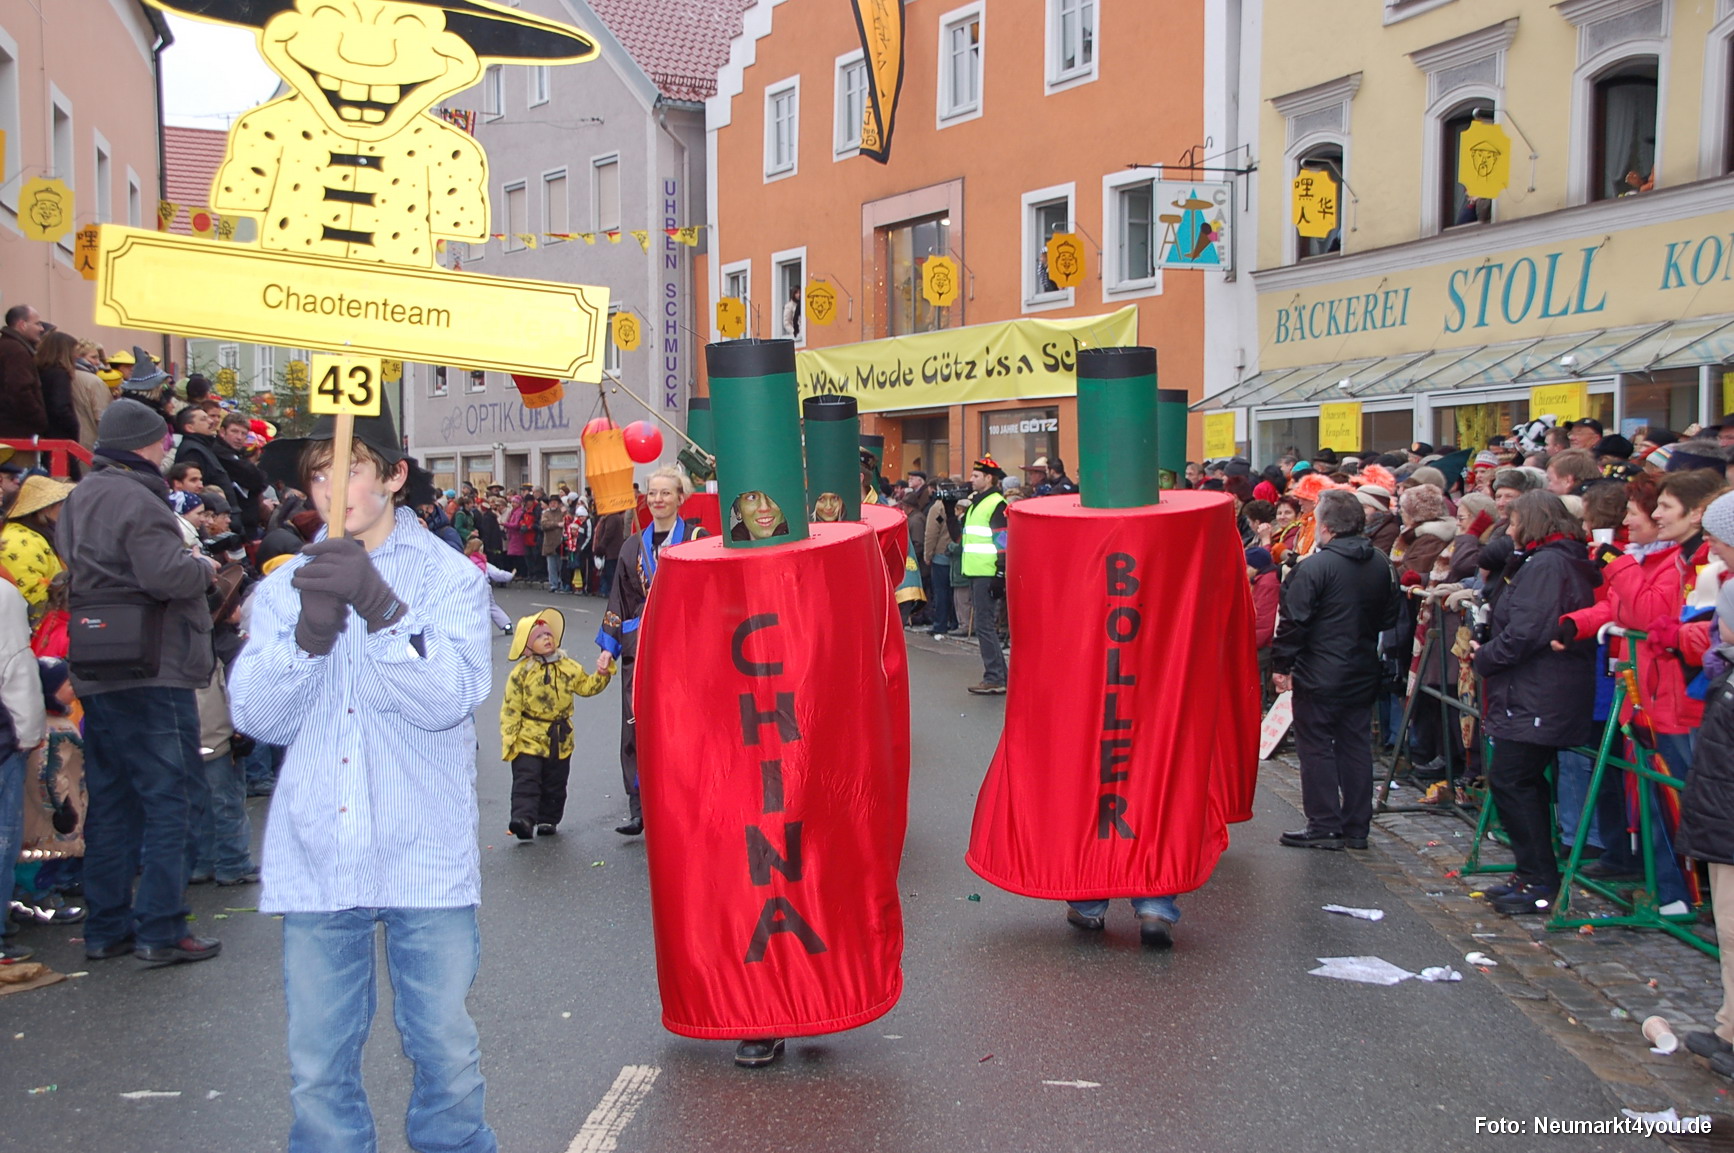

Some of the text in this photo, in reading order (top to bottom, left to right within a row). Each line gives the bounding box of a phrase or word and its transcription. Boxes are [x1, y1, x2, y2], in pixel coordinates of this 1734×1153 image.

[262, 283, 451, 328] Chaotenteam
[664, 180, 678, 408] UHREN SCHMUCK
[1274, 287, 1413, 344] BÄCKEREI
[1443, 246, 1608, 335] STOLL
[317, 365, 374, 407] 43
[856, 358, 914, 392] Mode
[922, 352, 977, 385] Götz
[465, 401, 570, 435] OPTIK OEXL
[989, 418, 1058, 435] 100 JAHRE GÖTZ
[731, 613, 828, 965] CHINA
